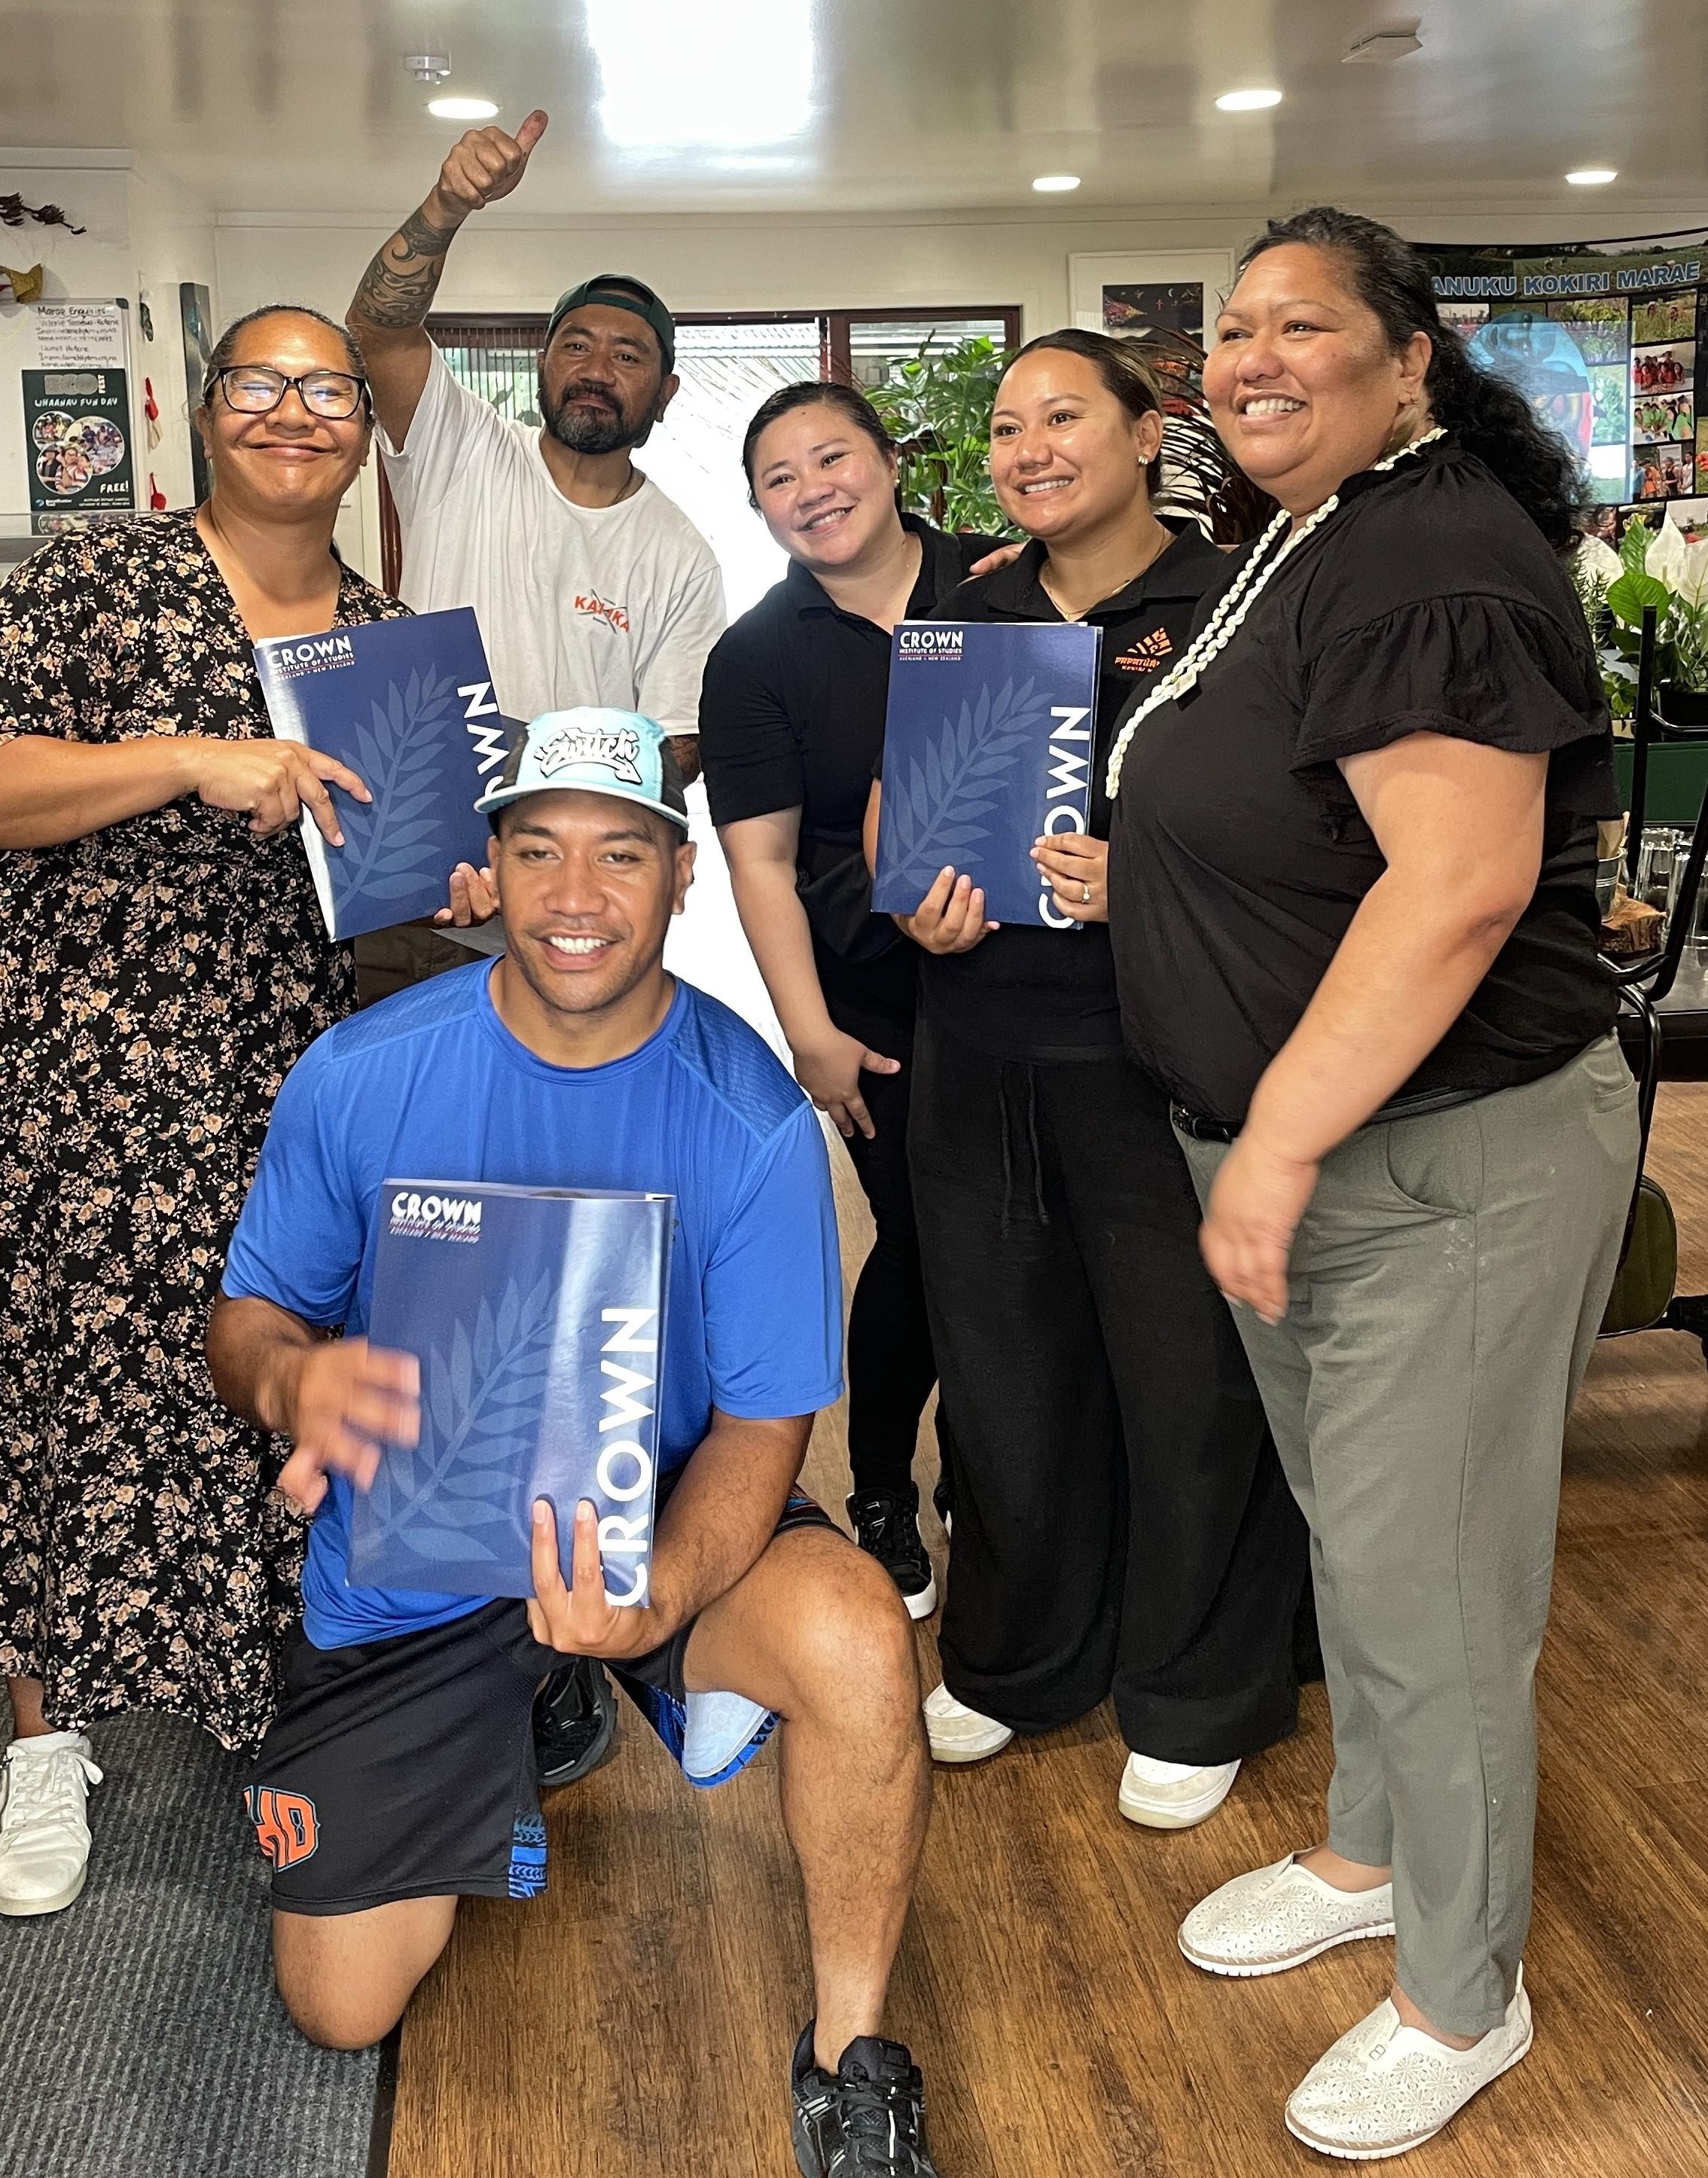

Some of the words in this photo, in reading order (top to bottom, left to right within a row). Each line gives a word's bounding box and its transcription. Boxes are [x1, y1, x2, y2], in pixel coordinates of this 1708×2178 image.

[1523, 273, 1610, 296] KOKIRI
[1616, 261, 1701, 289] MARAE
[35, 398, 78, 407] WHAANAU
[80, 398, 99, 407] FUN
[100, 397, 118, 406] DAY
[99, 480, 129, 493] FREE!
[266, 635, 352, 668] CROWN
[900, 630, 963, 648] CROWN
[392, 1192, 482, 1225] CROWN
